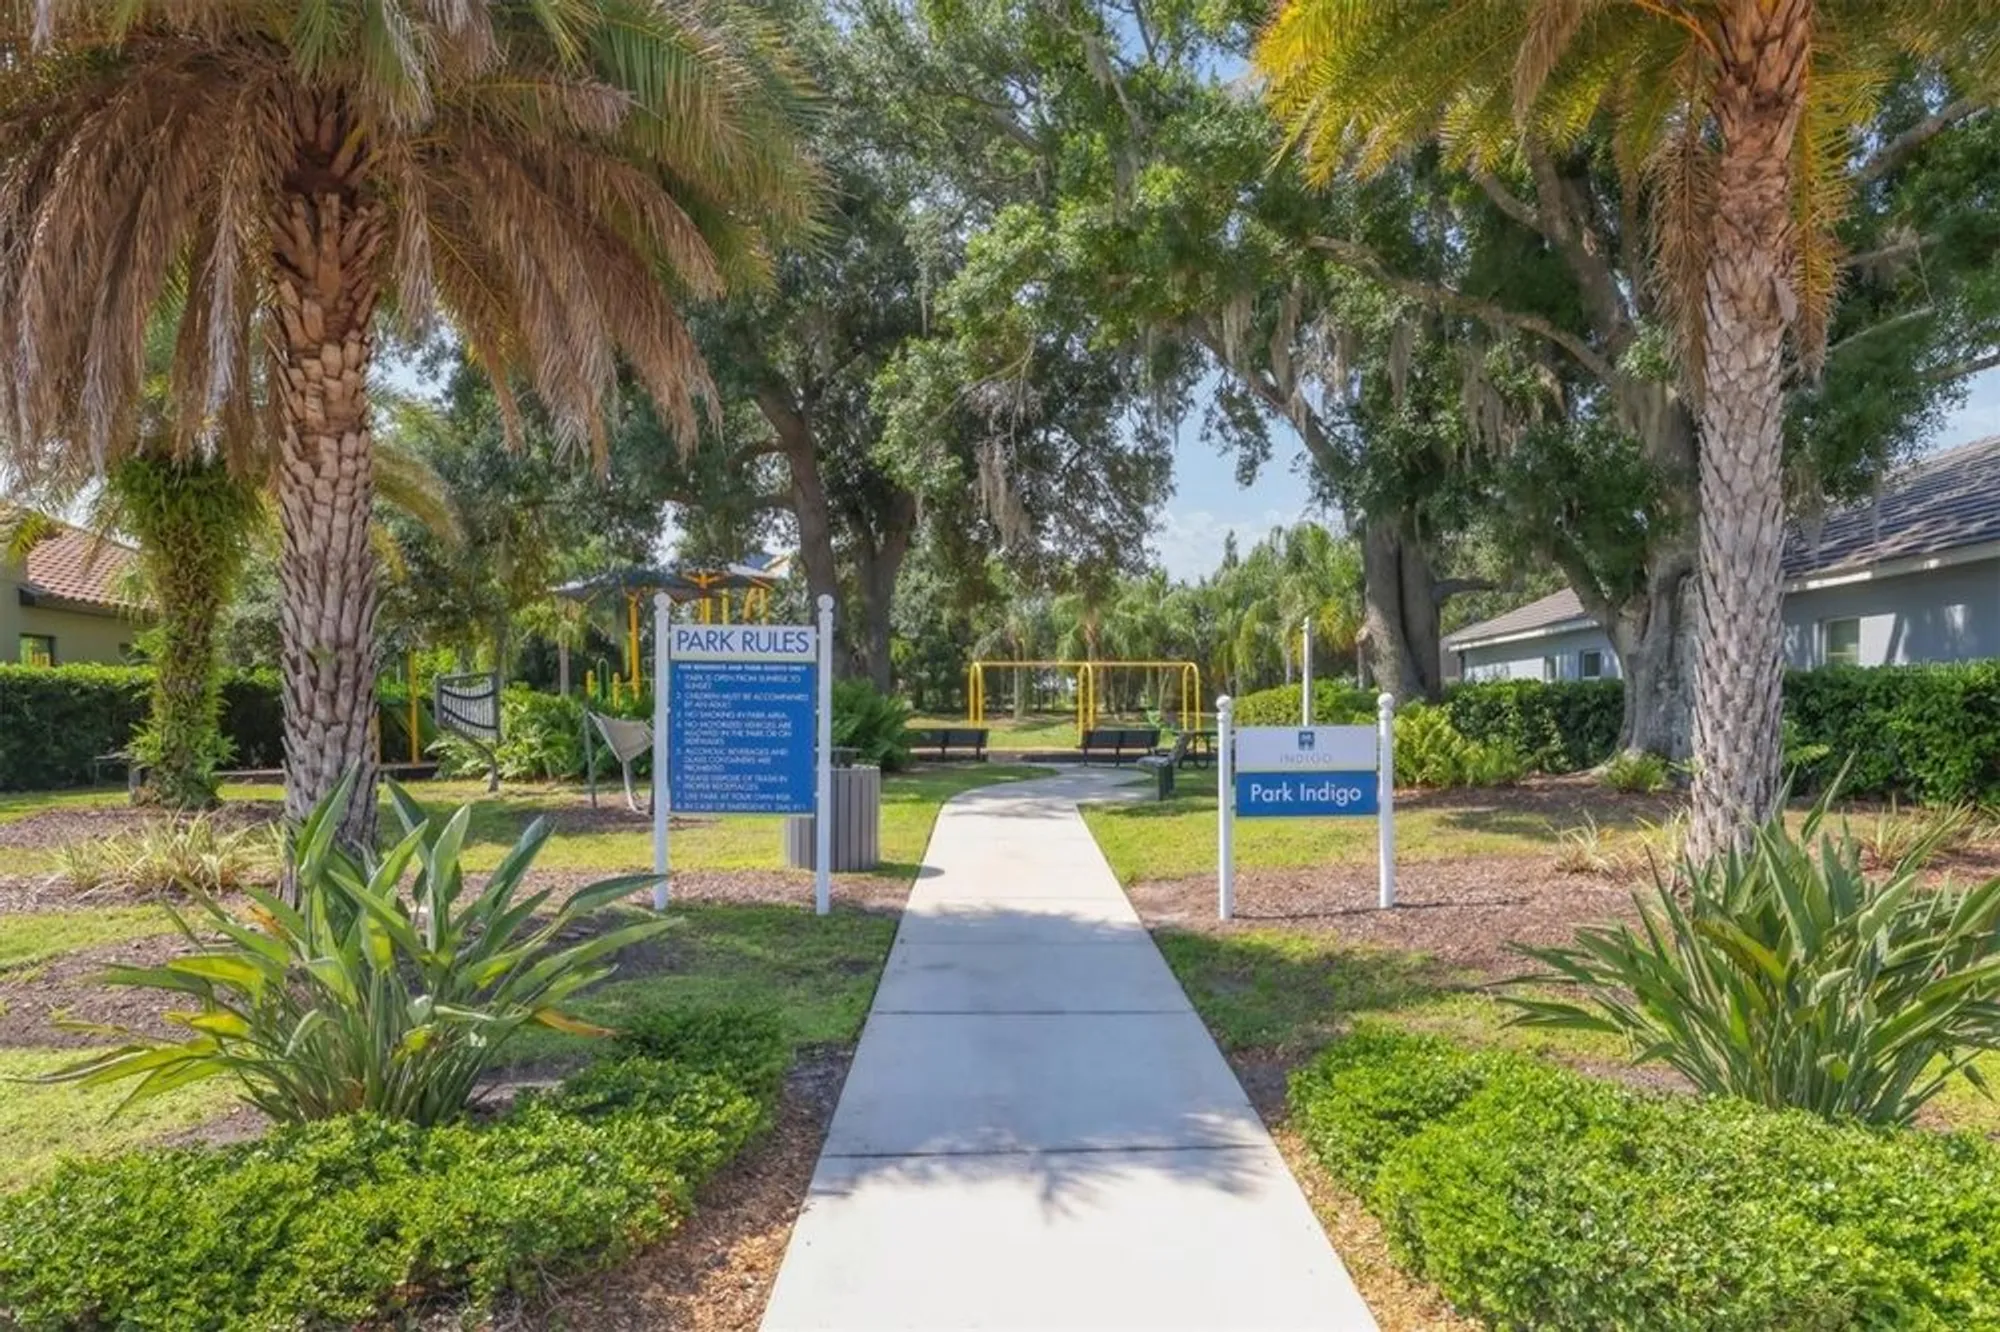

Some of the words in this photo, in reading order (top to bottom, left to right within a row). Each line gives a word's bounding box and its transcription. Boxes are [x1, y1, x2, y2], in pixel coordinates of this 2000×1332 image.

[677, 630, 735, 652] PARK
[741, 631, 809, 653] RULES
[736, 674, 758, 682] FROM
[684, 720, 699, 728] NO
[1280, 753, 1332, 764] INDIGO
[1251, 782, 1293, 802] Park
[1300, 782, 1362, 807] Indigo
